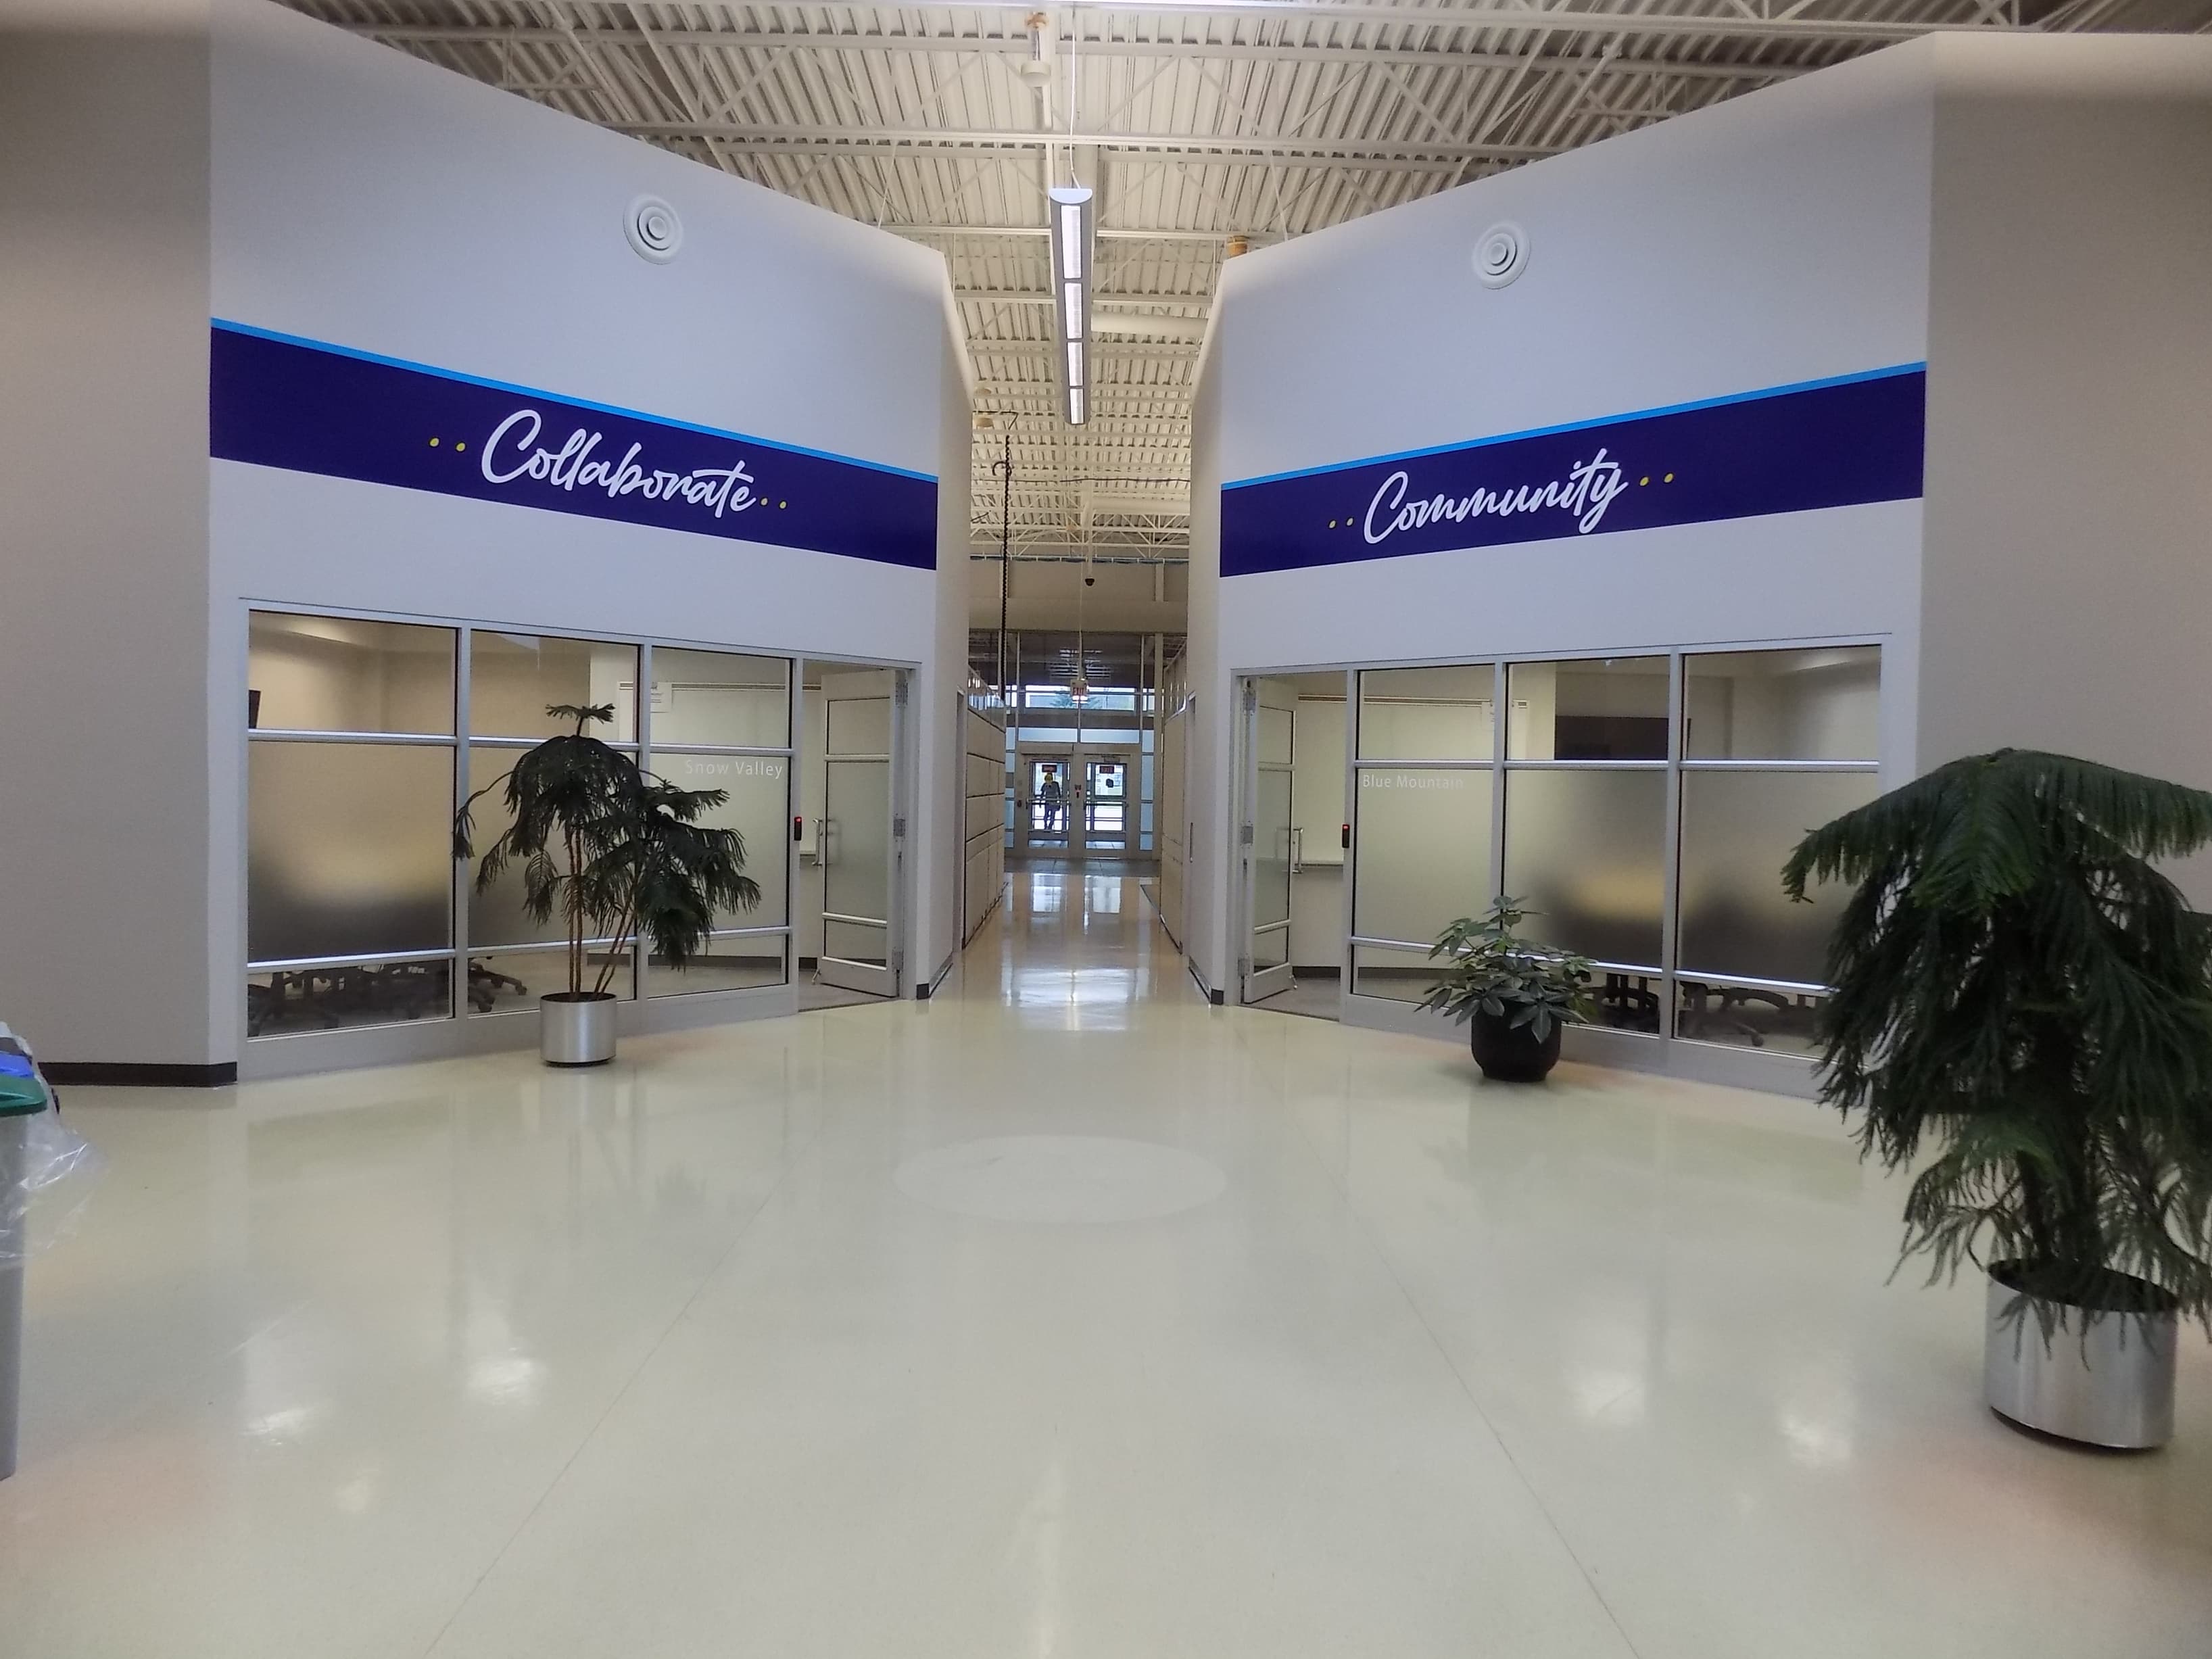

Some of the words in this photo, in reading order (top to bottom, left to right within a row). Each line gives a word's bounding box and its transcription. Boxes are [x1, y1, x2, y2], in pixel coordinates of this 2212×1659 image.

[481, 409, 756, 518] Collaborate
[1364, 448, 1629, 543] Community
[686, 759, 729, 774] Snow
[735, 761, 783, 779] Valley
[1362, 773, 1391, 788] Blue
[1396, 775, 1464, 790] Mountain
